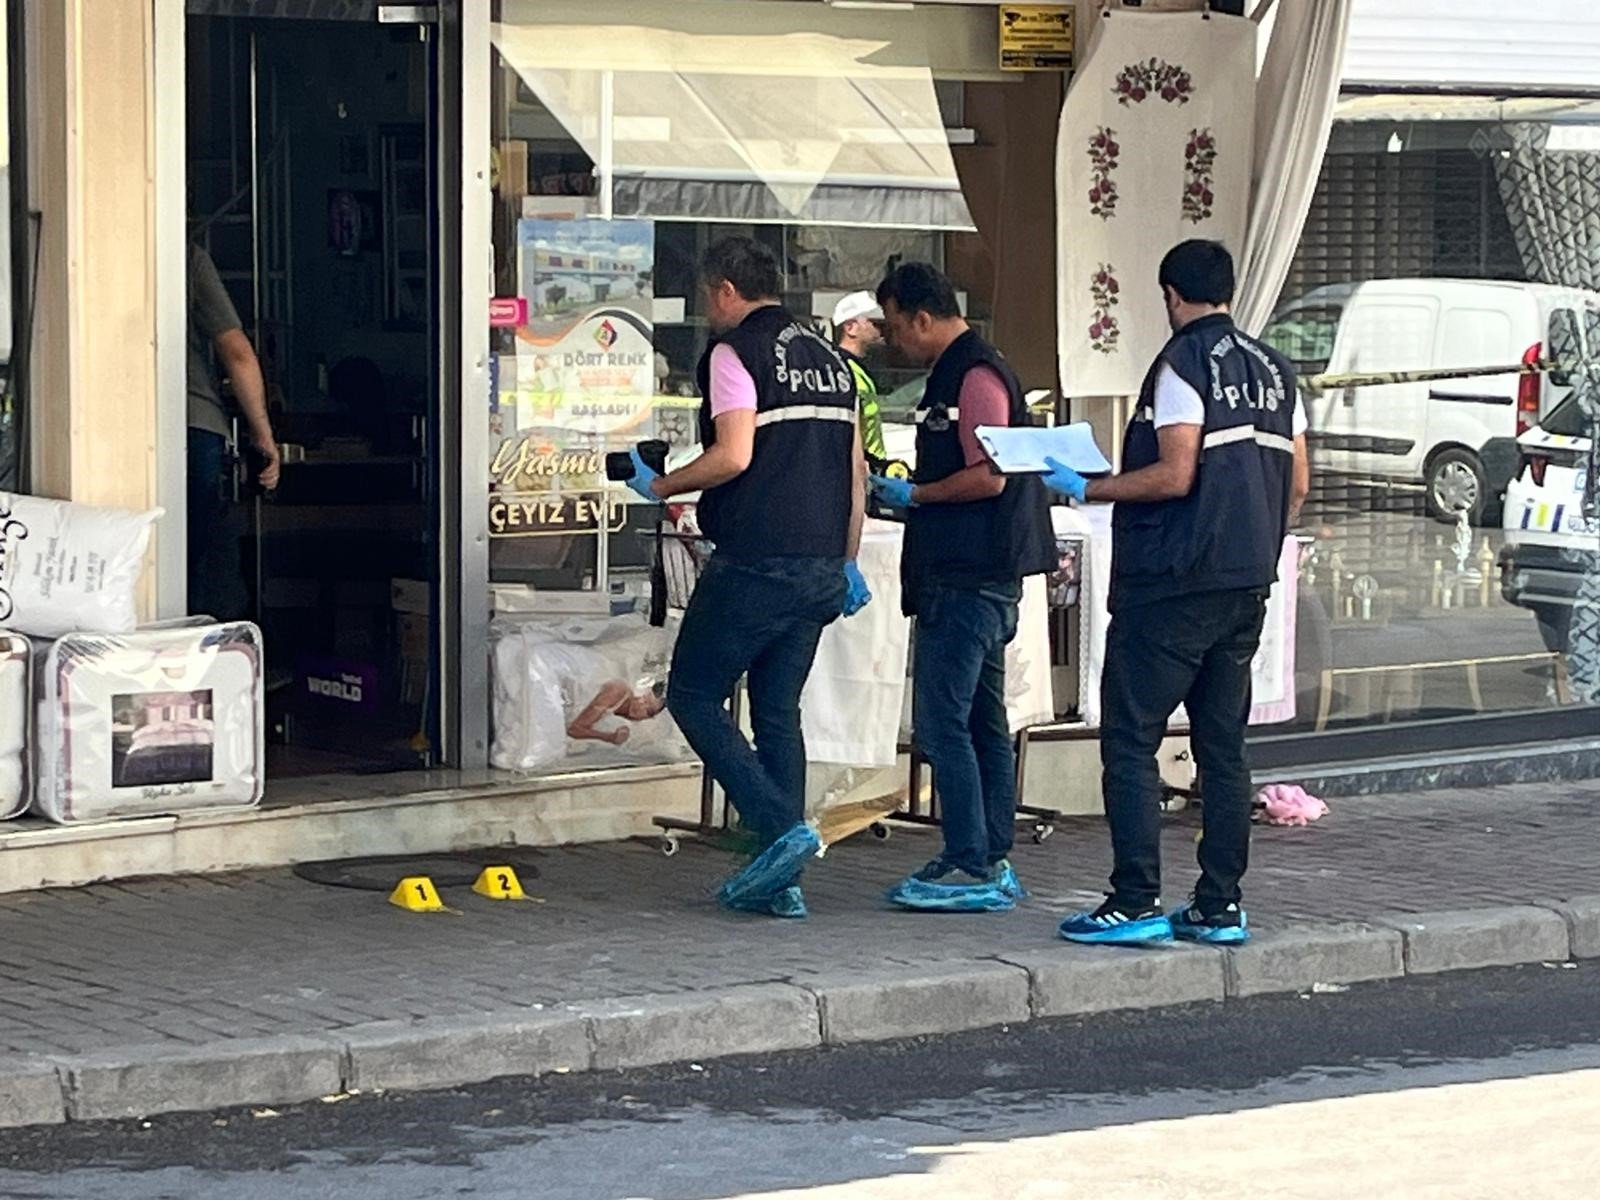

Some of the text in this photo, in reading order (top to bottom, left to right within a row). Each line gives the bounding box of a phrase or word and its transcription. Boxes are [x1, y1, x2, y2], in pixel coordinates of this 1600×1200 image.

[608, 353, 647, 367] RENK
[491, 438, 606, 485] Yasmi
[307, 677, 362, 701] WORLD
[497, 873, 511, 891] 2
[415, 884, 427, 901] 1
